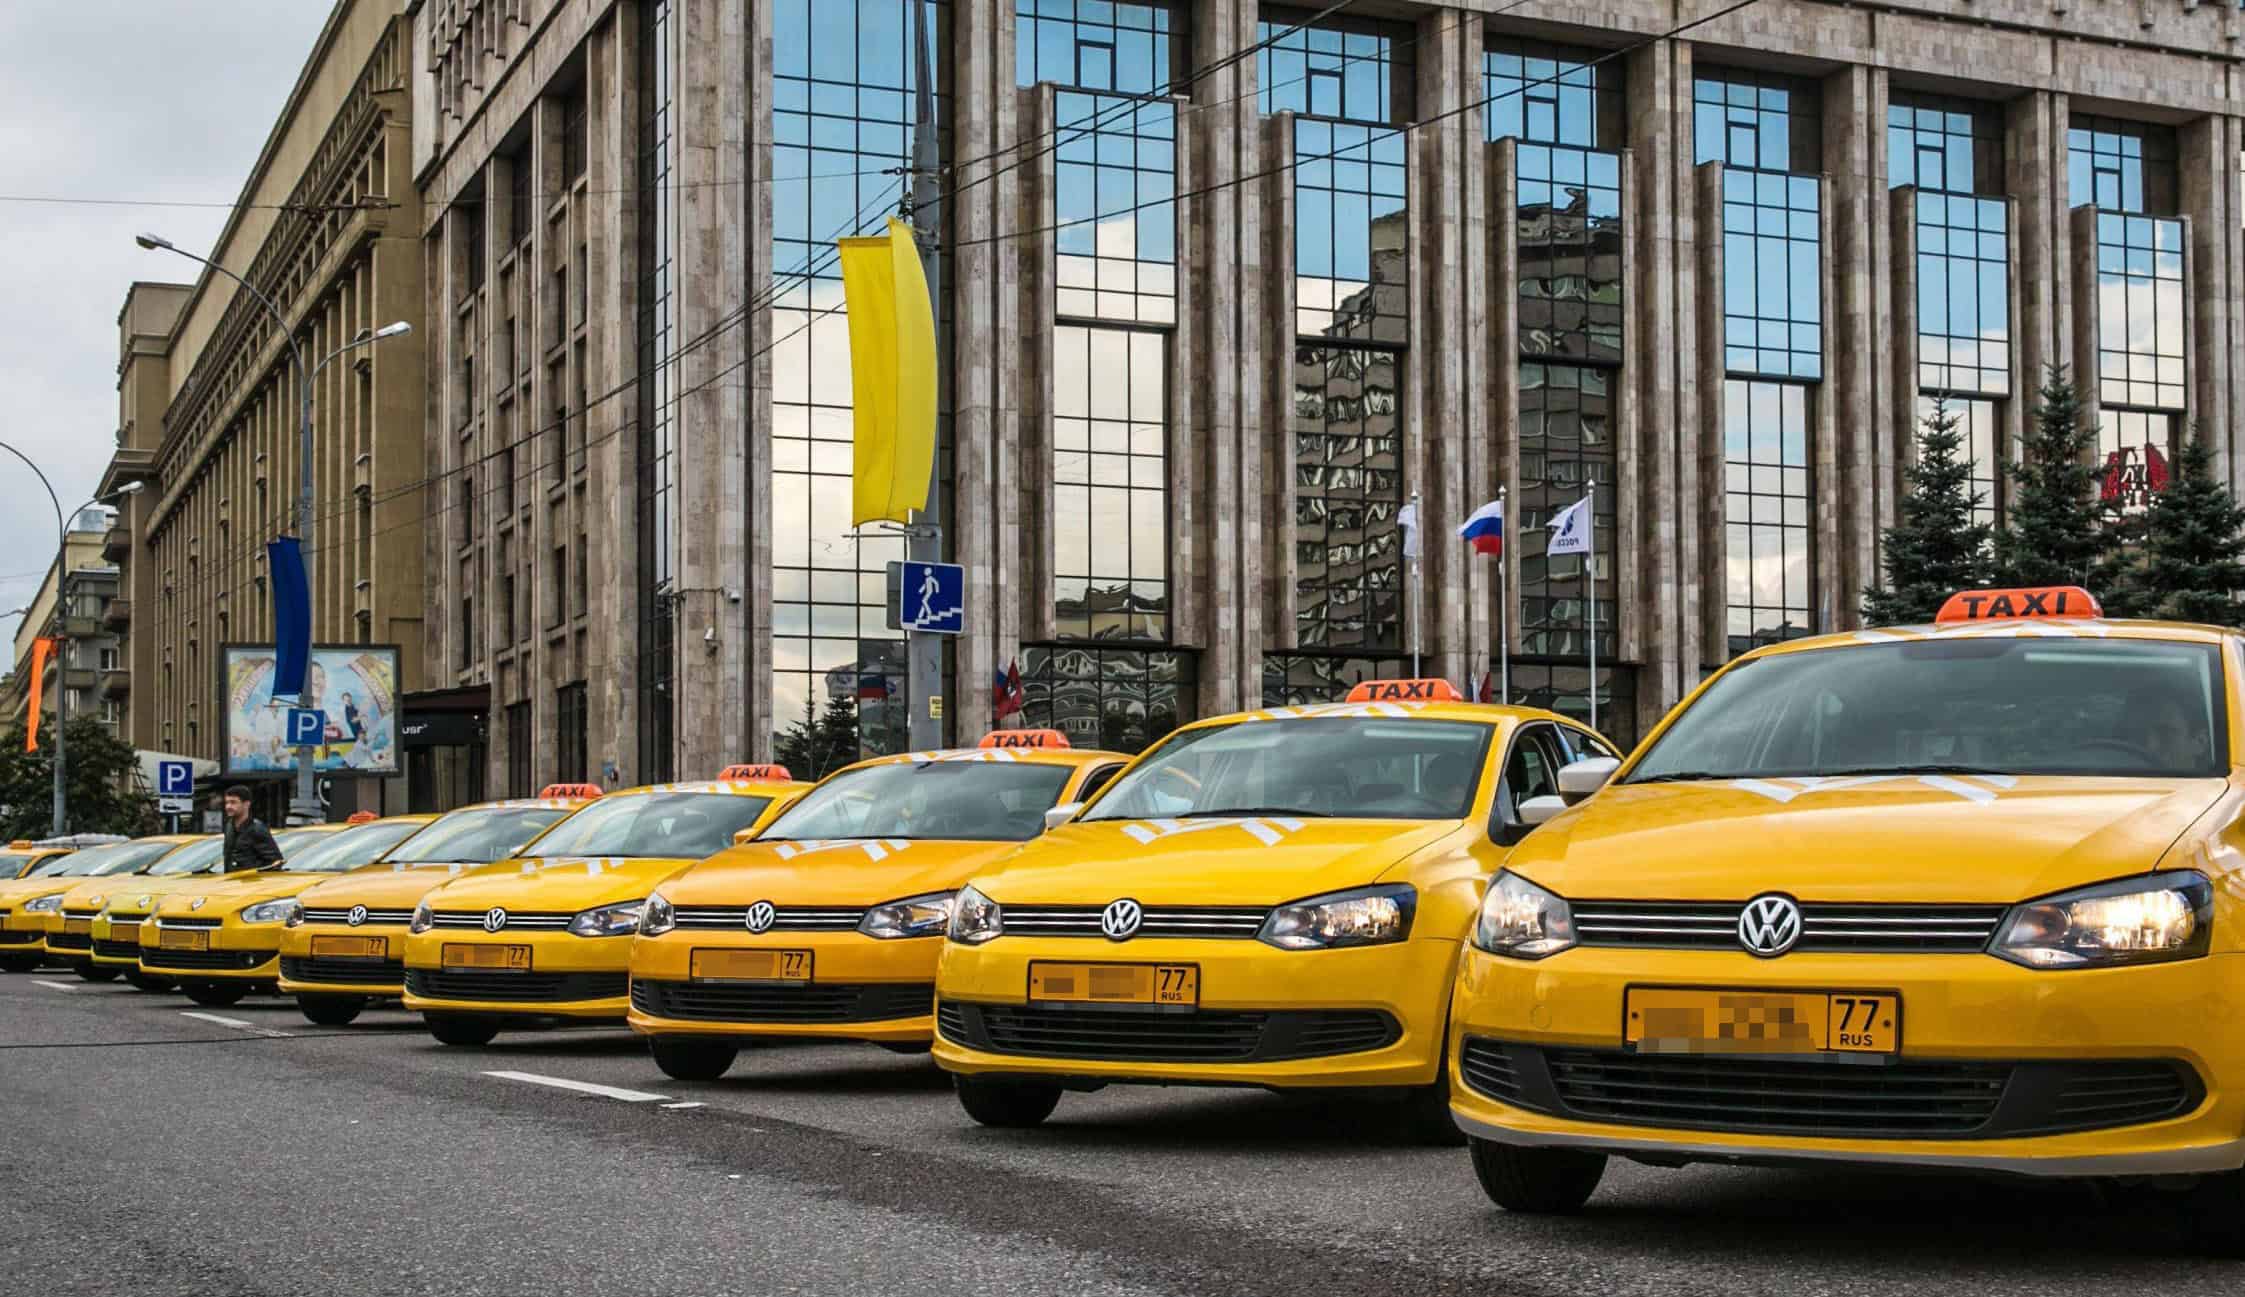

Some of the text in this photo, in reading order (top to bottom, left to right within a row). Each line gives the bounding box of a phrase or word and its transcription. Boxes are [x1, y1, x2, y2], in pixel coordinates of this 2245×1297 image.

[1961, 591, 2068, 618] TAXI
[1365, 682, 1435, 699] TAXI
[297, 712, 318, 741] P
[993, 734, 1044, 747] TAXI
[167, 764, 186, 791] P
[730, 767, 769, 778] TAXI
[550, 786, 585, 797] TAXI
[746, 902, 775, 931] VW
[1102, 900, 1141, 937] VW
[1740, 897, 1799, 953] VW
[511, 947, 525, 961] 77
[784, 952, 804, 969] 77
[1159, 969, 1187, 991] 77
[1161, 992, 1182, 1000] RUS
[1835, 998, 1879, 1032] 77
[1839, 1034, 1873, 1046] RUS
